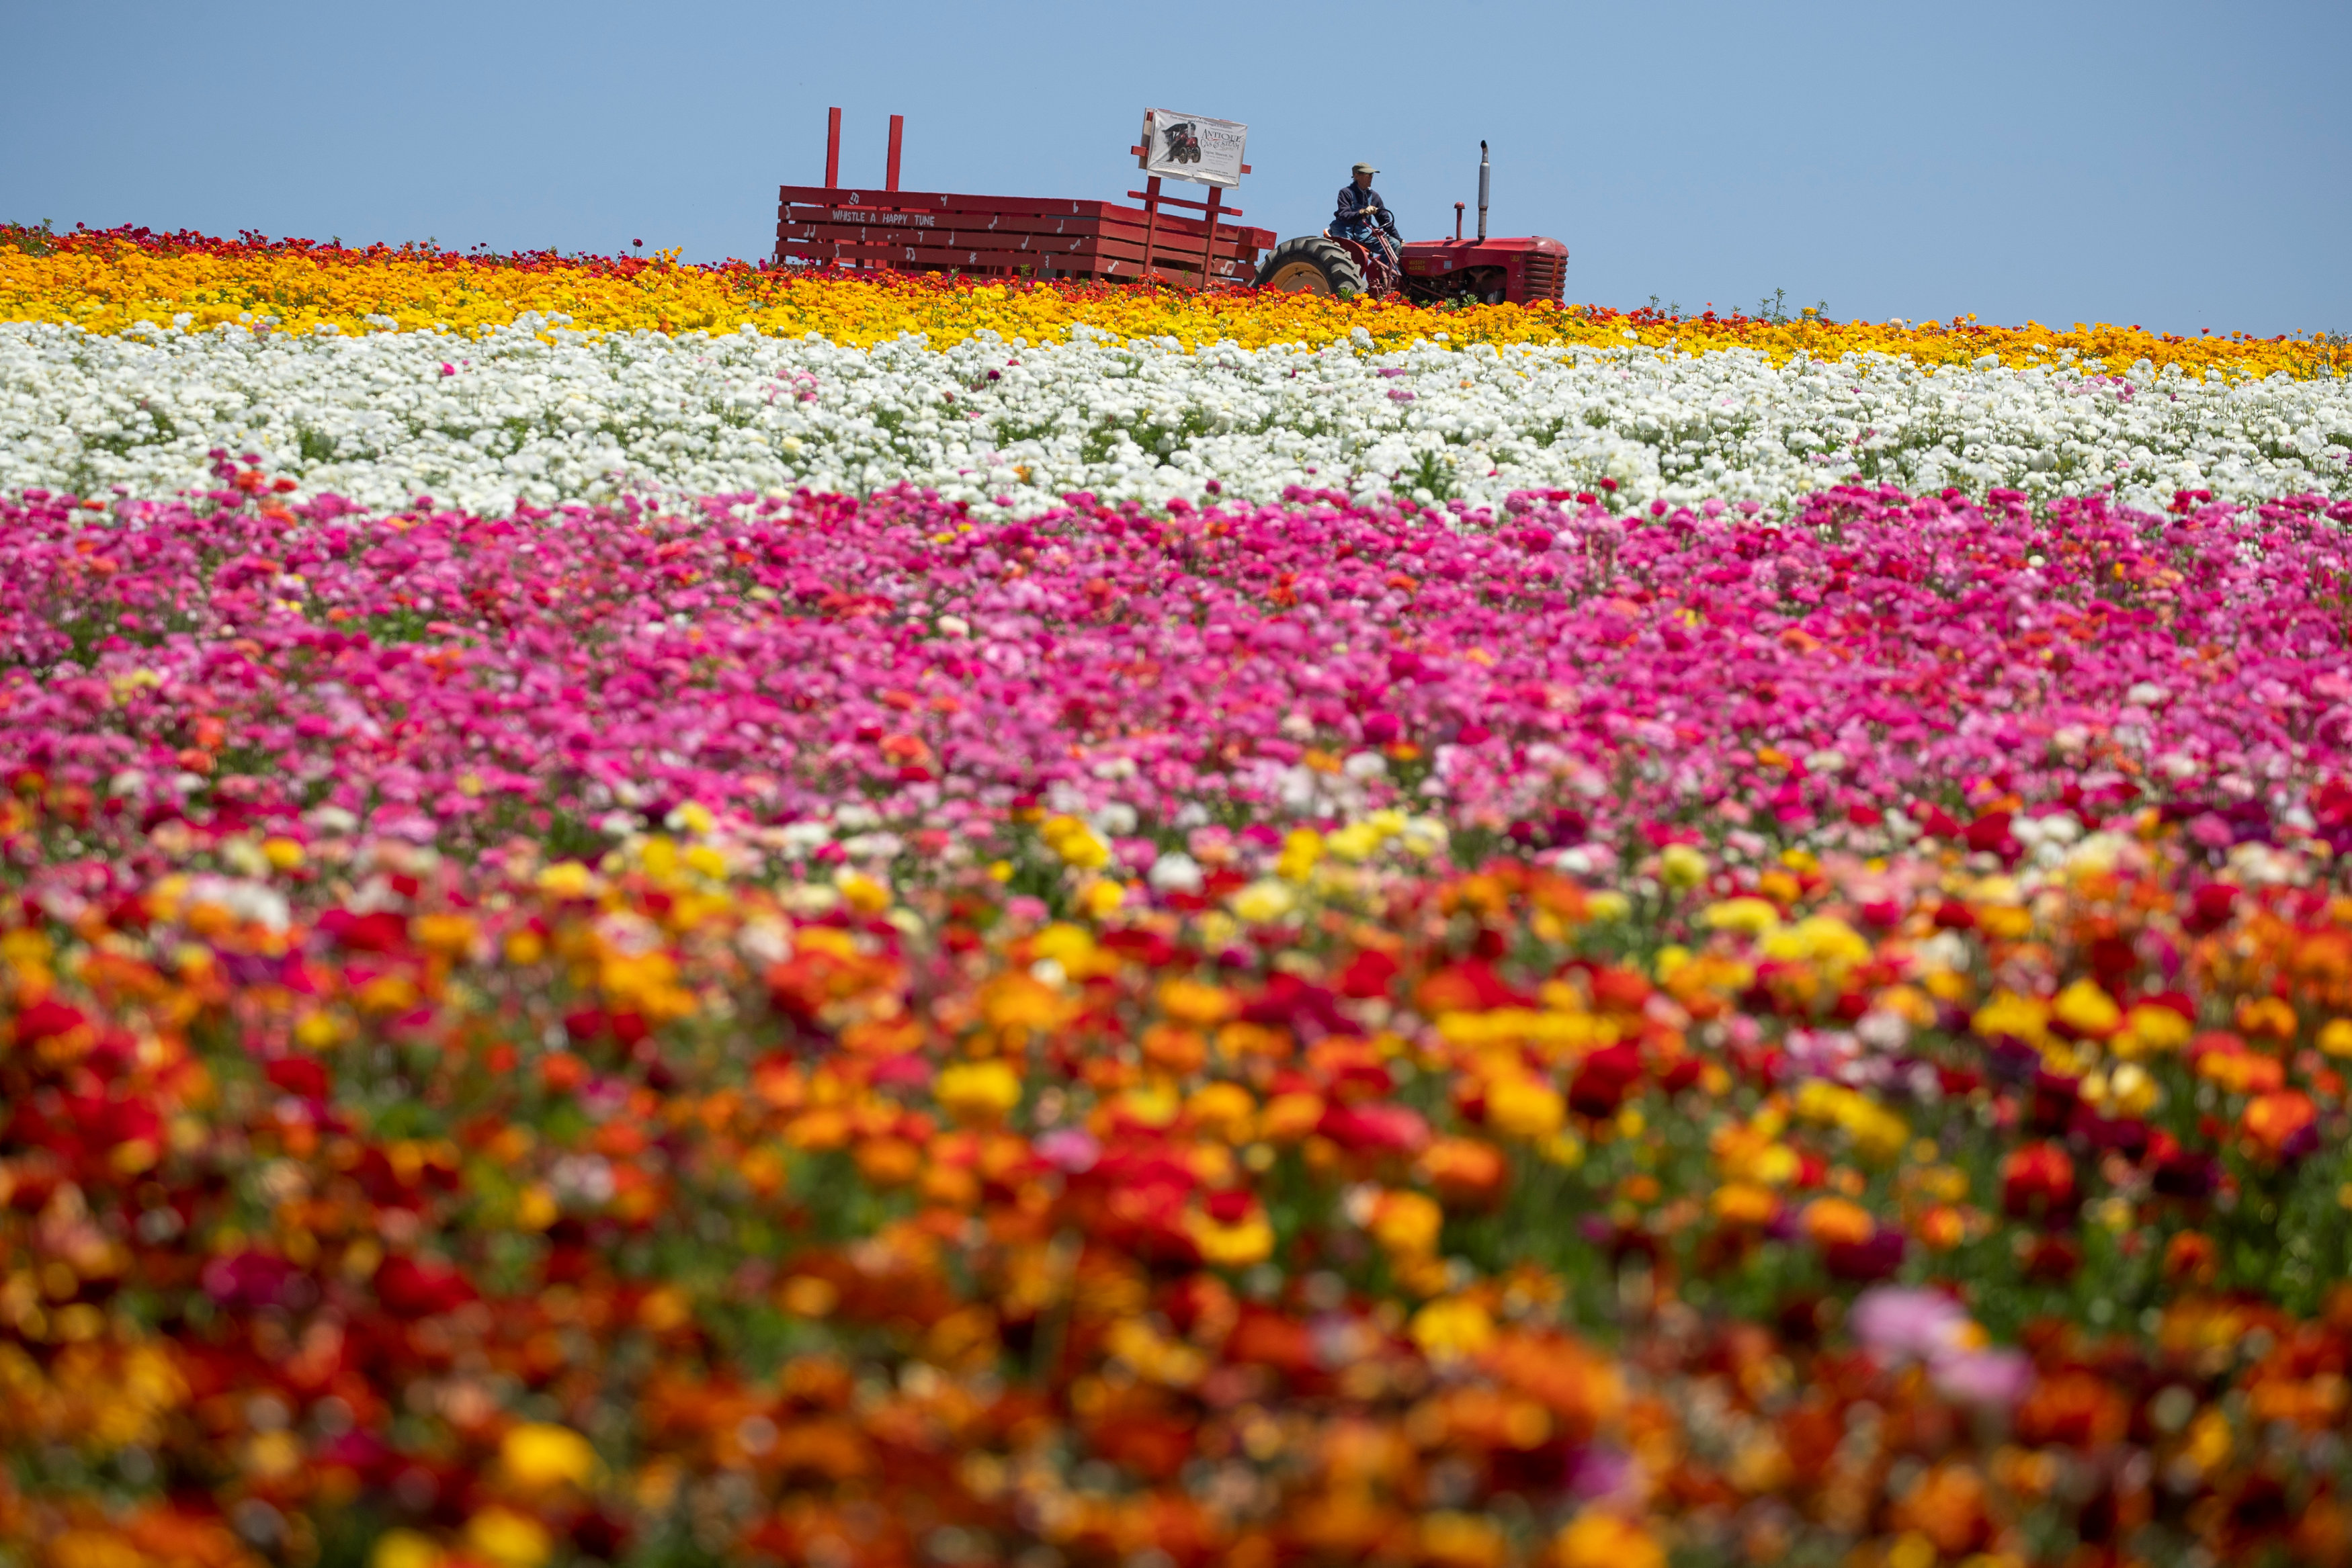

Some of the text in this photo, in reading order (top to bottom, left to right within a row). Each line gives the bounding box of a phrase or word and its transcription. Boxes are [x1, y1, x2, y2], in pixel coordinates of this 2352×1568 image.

[1202, 128, 1241, 143] ANTIQUE
[1200, 138, 1212, 148] GAS
[1213, 140, 1220, 148] &
[1220, 140, 1239, 150] STEAM
[833, 210, 935, 227] WHISTLE A HAPPY TUNE
